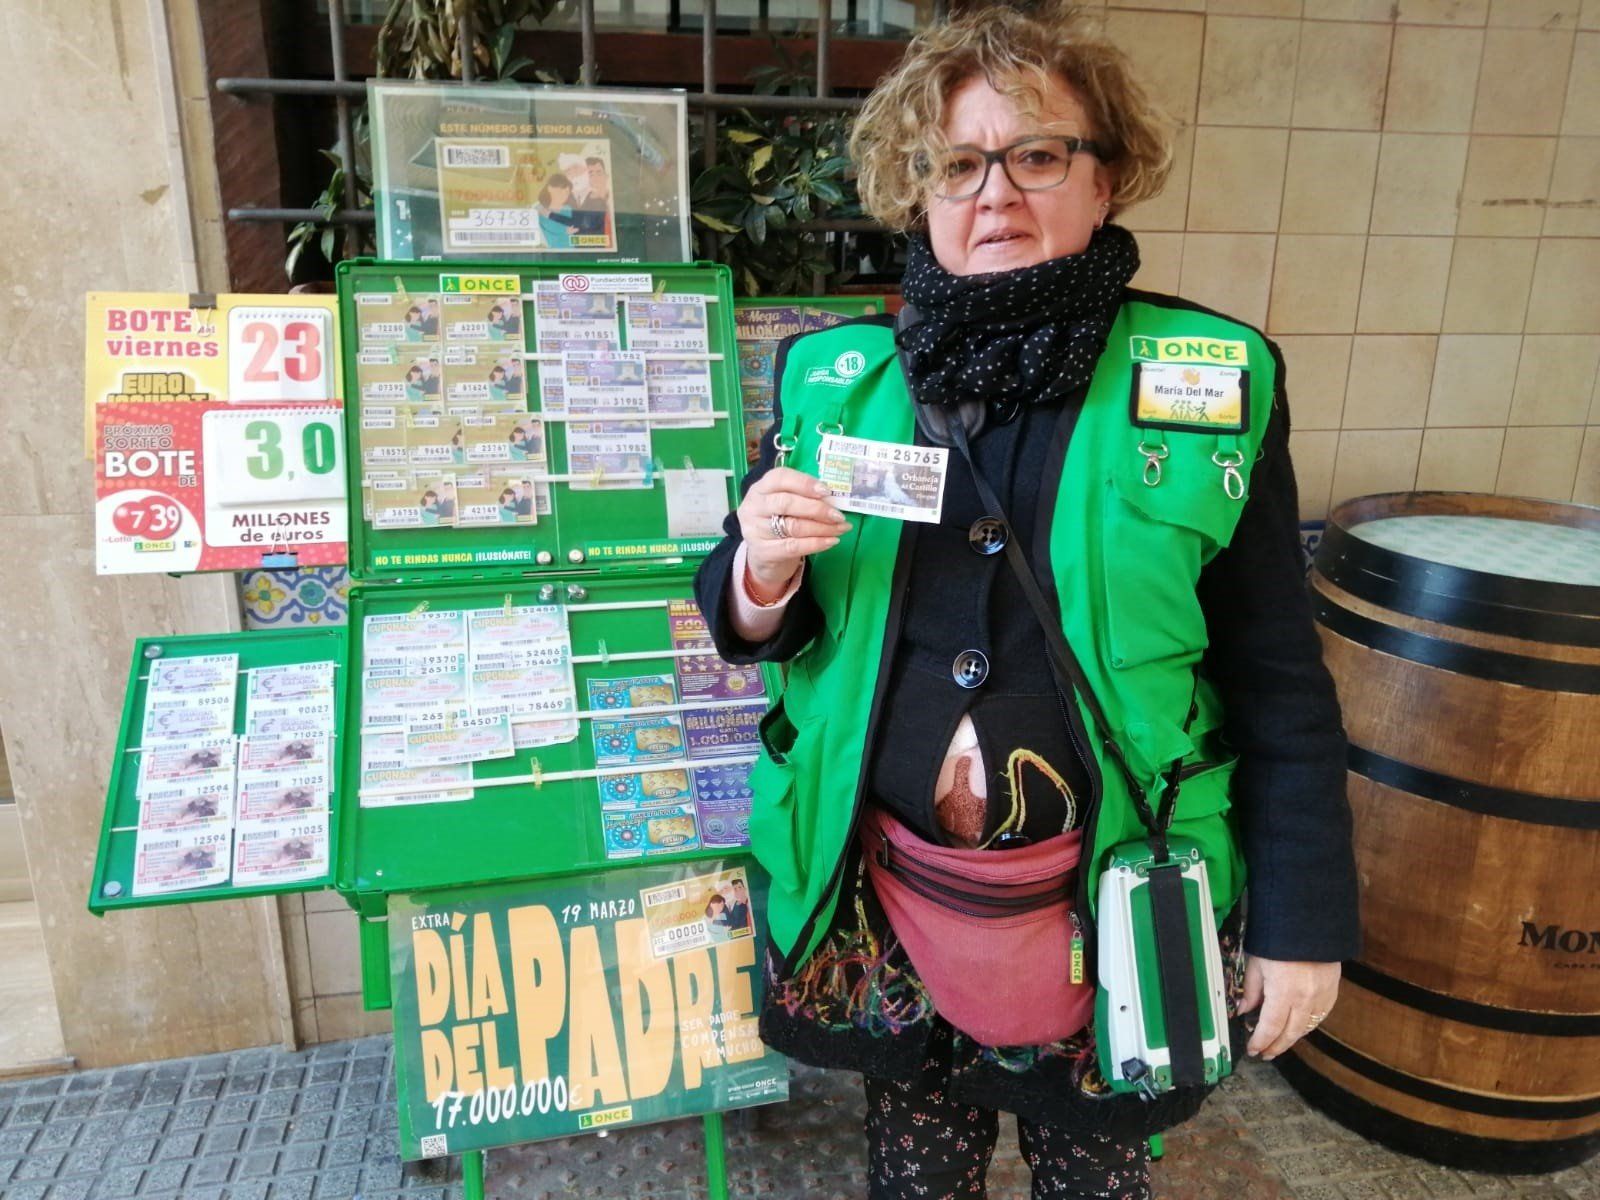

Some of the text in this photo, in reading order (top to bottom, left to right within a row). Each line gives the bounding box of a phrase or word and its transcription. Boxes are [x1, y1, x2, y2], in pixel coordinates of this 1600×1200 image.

[440, 123, 604, 136] ESTE NÚMERO SE VENDE AQUÍ
[473, 210, 531, 229] 36758
[464, 279, 516, 291] ONCE
[107, 309, 192, 333] BOTE
[106, 336, 219, 357] viernes
[241, 321, 322, 382] 23
[1164, 342, 1240, 361] ONCE
[1154, 384, 1225, 398] María Del Mar
[104, 421, 174, 436] PRÓXIMO
[104, 436, 173, 449] SORTEO
[105, 449, 196, 478] BOTE
[893, 448, 941, 465] 28765
[178, 474, 197, 487] DE
[231, 511, 331, 528] MILLONES
[240, 528, 325, 543] de euros
[375, 555, 389, 565] NO
[390, 555, 402, 565] TE
[404, 554, 439, 565] RINDAS
[441, 553, 473, 563] NUNCA
[588, 546, 601, 556] NO
[603, 546, 613, 555] TE
[615, 545, 647, 555] RINDAS
[649, 544, 679, 553] NUNCA
[411, 911, 451, 930] EXTRA
[560, 899, 636, 924] 19 MARZO
[668, 922, 705, 941] 00000
[412, 911, 509, 1027] DÍA
[1073, 953, 1082, 981] ONCE
[681, 1009, 741, 1033] SER PADRE
[682, 1022, 760, 1049] COMPENSA
[420, 1020, 518, 1103] DEL
[755, 1077, 777, 1089] ONCE
[431, 1074, 584, 1130] 17.000.000€
[593, 1108, 631, 1123] ONCE
